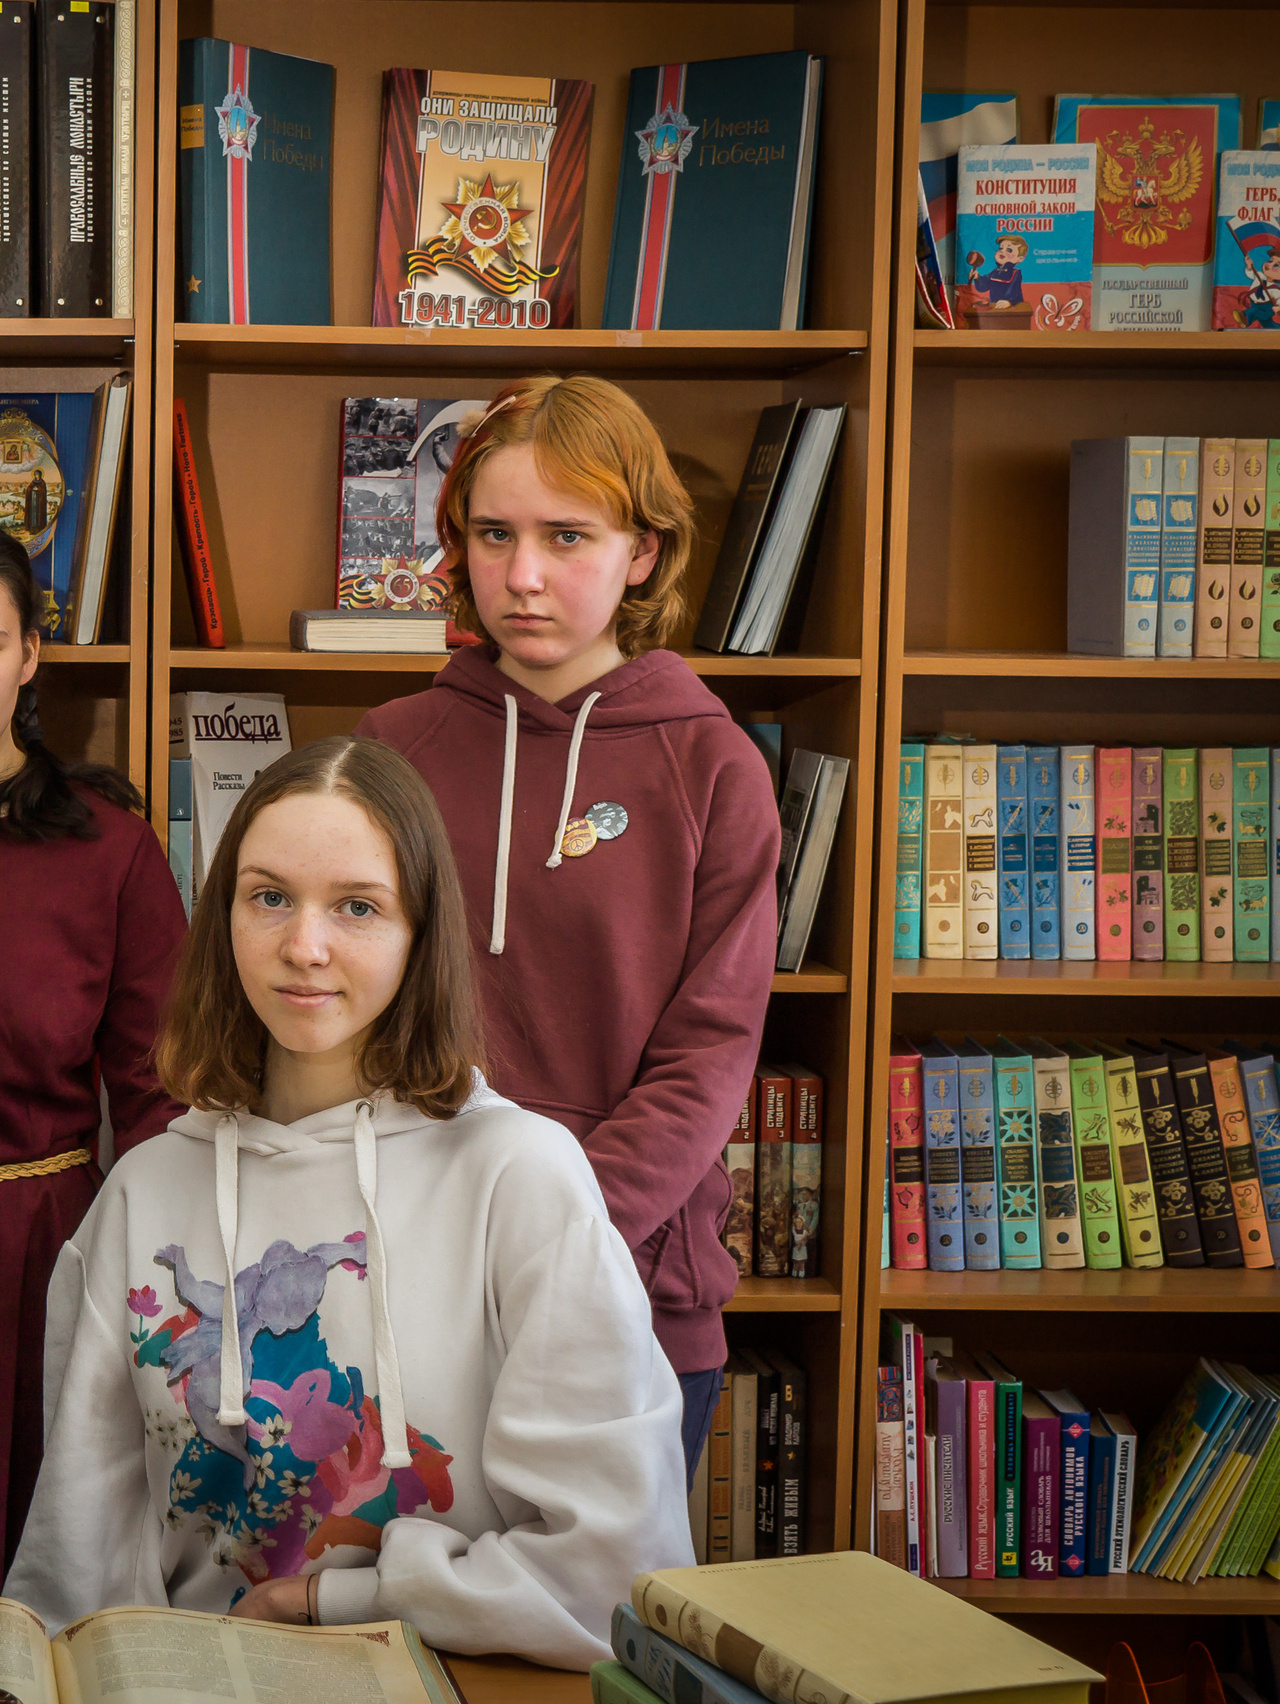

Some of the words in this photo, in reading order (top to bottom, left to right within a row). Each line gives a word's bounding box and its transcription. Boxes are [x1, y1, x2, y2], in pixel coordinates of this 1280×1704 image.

[420, 96, 456, 116] ОНИ
[459, 98, 558, 125] ЗАЩИЩАЛИ
[262, 112, 312, 141] Имена
[416, 114, 557, 163] РОДИНУ
[701, 117, 770, 140] Имена
[261, 139, 324, 171] Победы
[699, 143, 785, 167] Победы
[966, 159, 989, 173] МОЯ
[991, 159, 1033, 172] РОДИНА
[1047, 157, 1090, 171] РОССИЯ
[975, 178, 1077, 197] КОНСТИТУЦИЯ
[461, 198, 507, 243] ОТЕЧЕСТВЕННАЯ
[492, 215, 511, 244] ВОЙНА
[974, 201, 1038, 216] ОСНОВНОЙ
[1040, 201, 1076, 216] ЗАКОН
[1237, 206, 1275, 222] ФЛАГ
[996, 218, 1054, 233] РОССИИ
[1102, 279, 1189, 292] ГОСУДАРСТВЕННЫЙ
[1128, 293, 1162, 309] ГЕРБ
[399, 289, 551, 329] 1941-2010
[1108, 309, 1184, 325] РОССИЙСКОЙ
[393, 578, 411, 594] 65
[192, 702, 282, 744] победа
[213, 771, 243, 781] Повести
[213, 781, 246, 790] Рассказы
[800, 1088, 808, 1130] СТРАНИЦЫ
[809, 1095, 817, 1130] ПОДВИГА
[976, 1390, 988, 1422] студента
[942, 1435, 952, 1481] ПИСАТЕЛИ
[977, 1430, 988, 1468] школьника
[1119, 1440, 1129, 1471] СЛОВАРЬ
[1065, 1446, 1075, 1500] АНТОНИМОВ
[1076, 1456, 1085, 1487] ЯЗЫКА
[785, 1479, 799, 1517] ЖИВЫМ
[943, 1484, 953, 1523] РУССКИЕ
[1006, 1487, 1014, 1510] ЯЗЫК
[1074, 1491, 1084, 1536] РУССКОГО
[1115, 1472, 1127, 1538] ЭТИМОЛОГИЧЕСКИЙ
[784, 1524, 798, 1554] ВЗЯТЬ
[1006, 1512, 1015, 1547] РУССКИЙ
[1064, 1505, 1074, 1546] СЛОВАРЬ
[1113, 1539, 1124, 1569] РУССКИЙ
